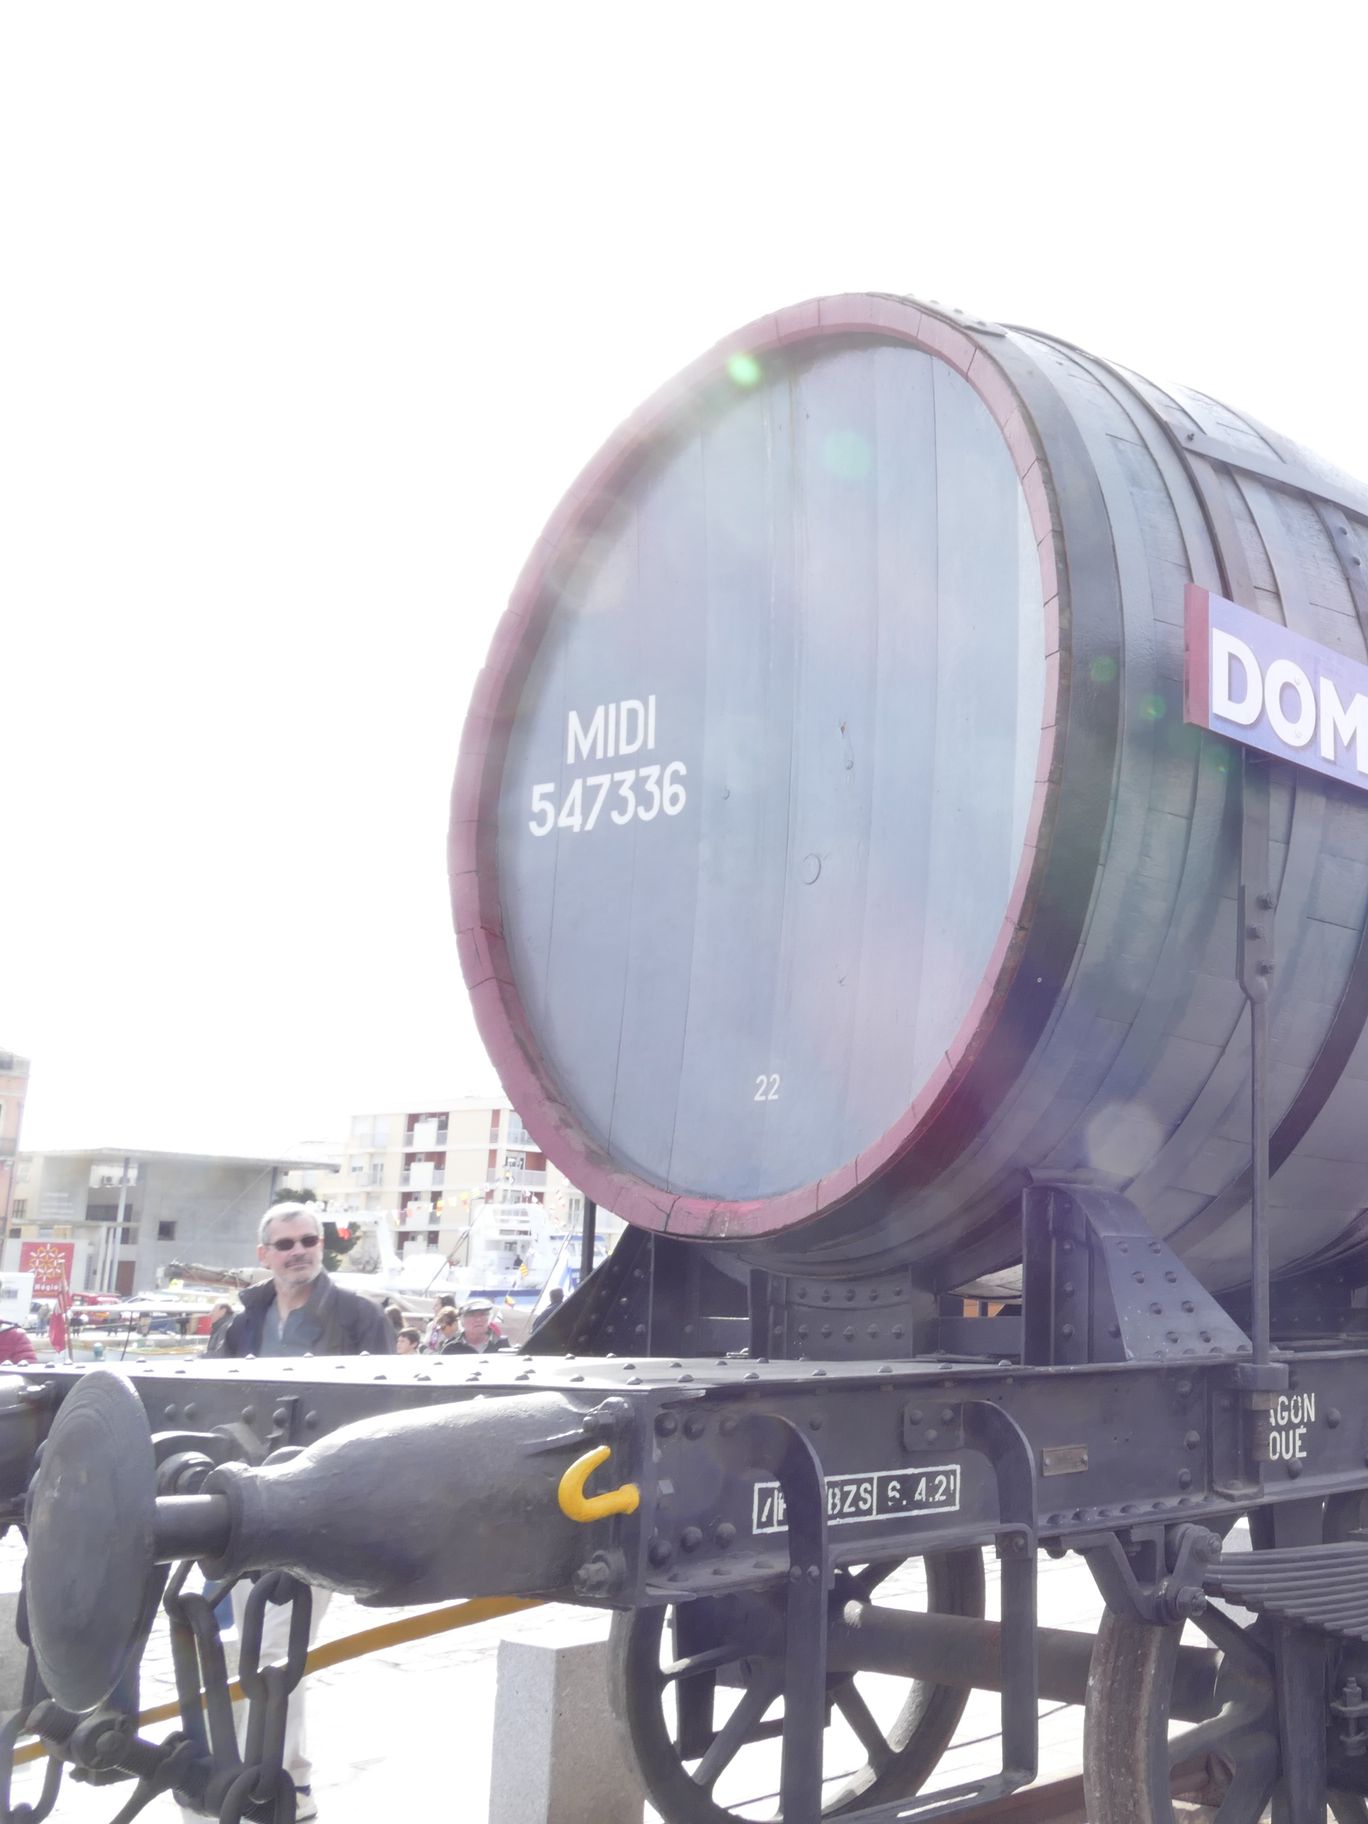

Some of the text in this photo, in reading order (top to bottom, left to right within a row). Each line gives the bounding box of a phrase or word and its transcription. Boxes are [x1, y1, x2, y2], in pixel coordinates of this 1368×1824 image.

[566, 694, 657, 765] MIDI
[528, 760, 688, 837] 547336
[753, 1073, 781, 1101] 22
[34, 1282, 62, 1292] Régio
[1269, 1424, 1308, 1460] OUÉ
[827, 1483, 873, 1515] BZS
